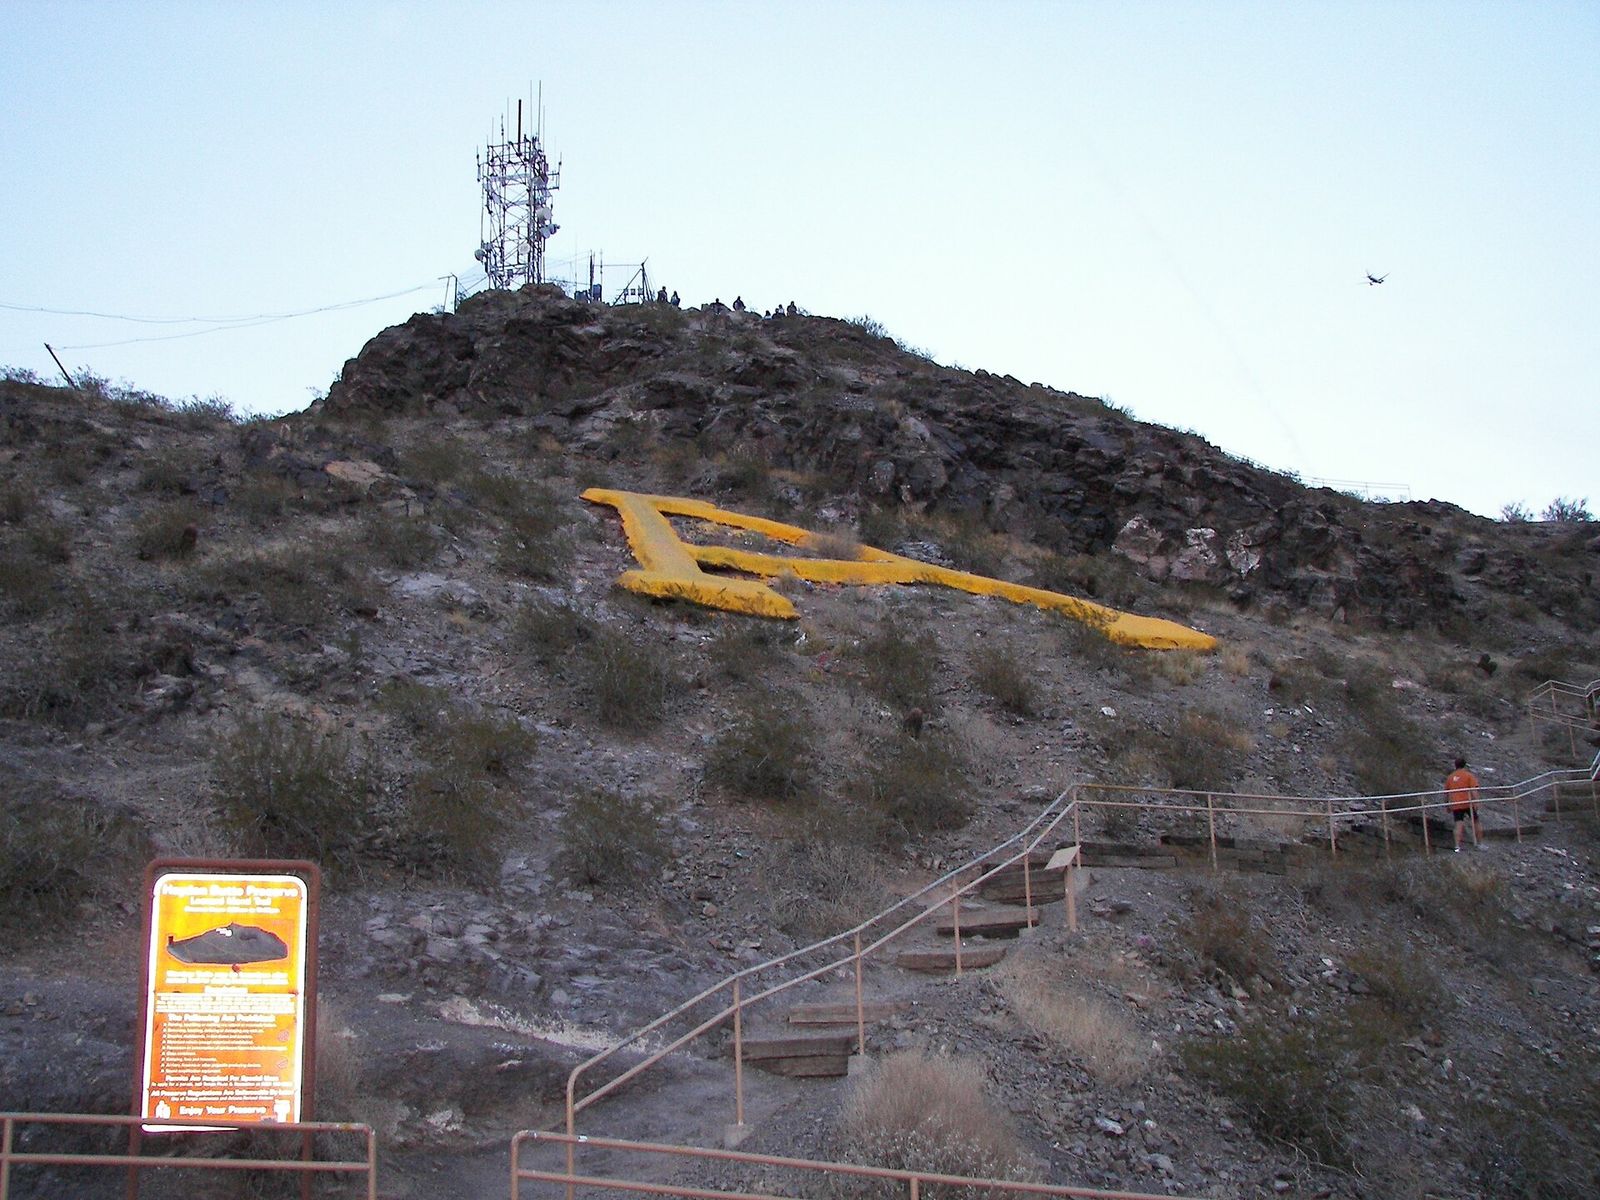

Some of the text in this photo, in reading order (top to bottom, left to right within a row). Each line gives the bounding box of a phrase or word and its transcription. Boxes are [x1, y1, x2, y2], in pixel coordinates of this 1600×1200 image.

[210, 884, 245, 897] Butte
[246, 885, 299, 897] Preserve
[179, 1105, 267, 1116] Enjoy Your Preserve
